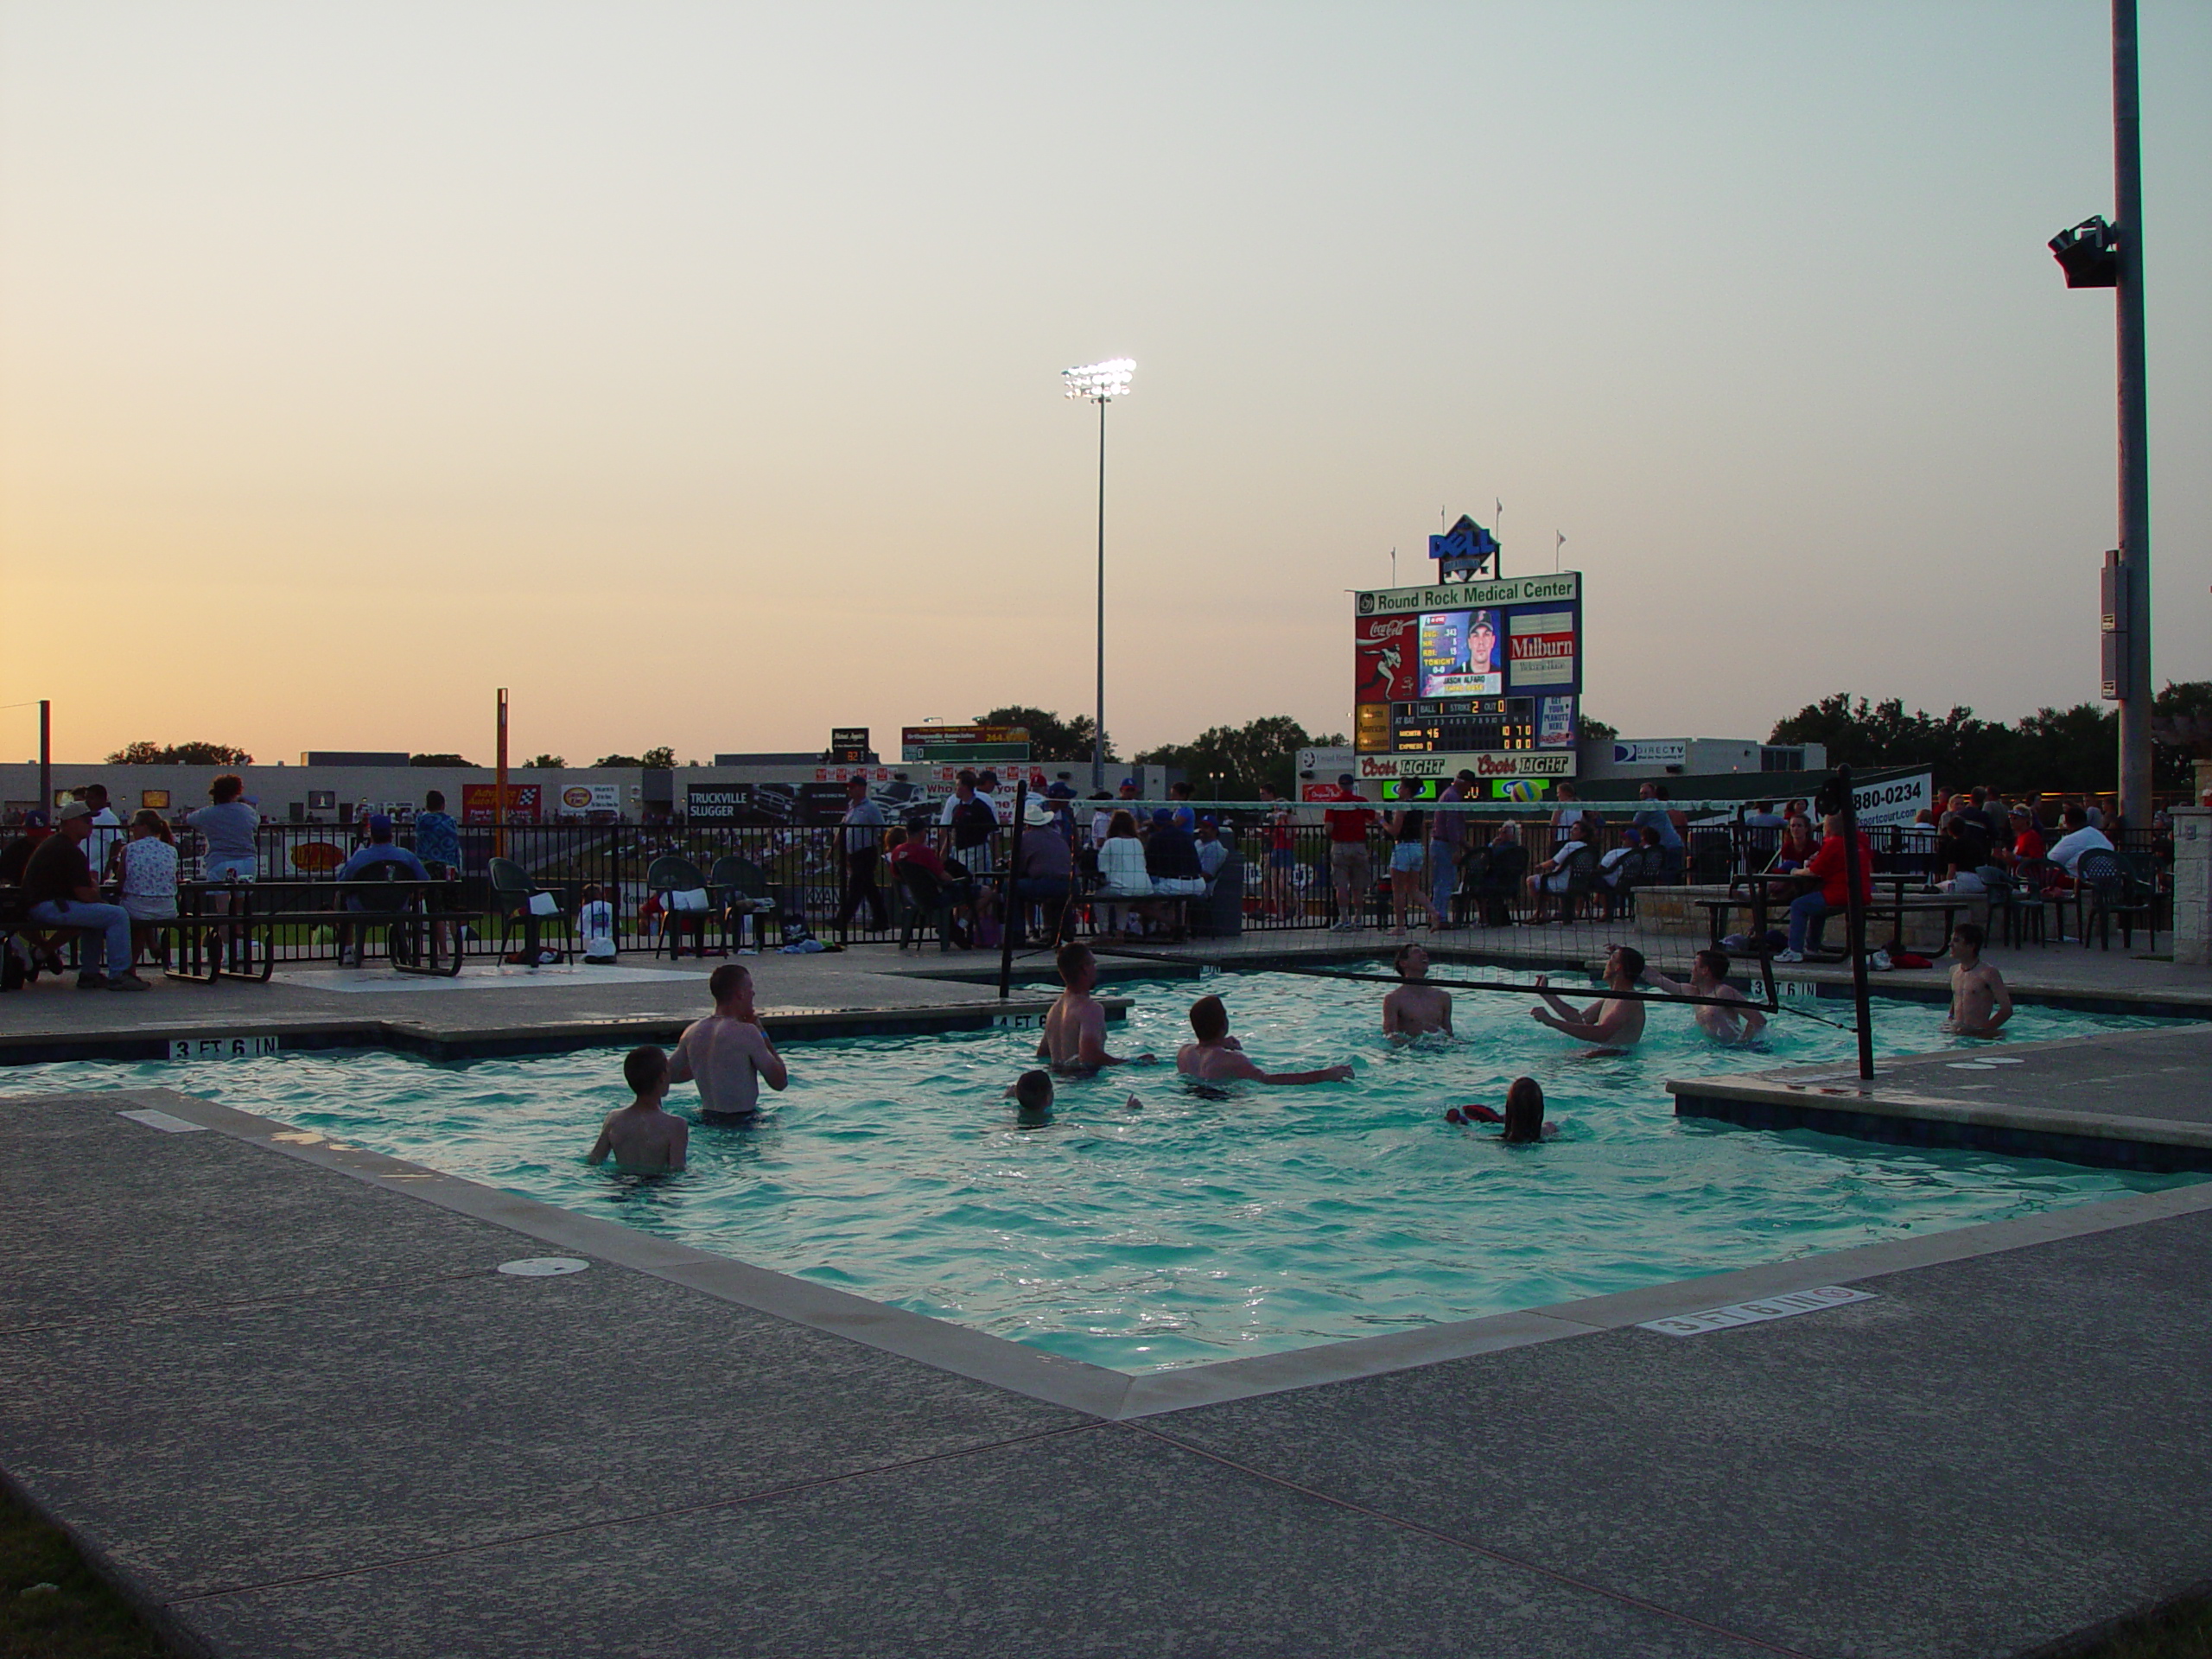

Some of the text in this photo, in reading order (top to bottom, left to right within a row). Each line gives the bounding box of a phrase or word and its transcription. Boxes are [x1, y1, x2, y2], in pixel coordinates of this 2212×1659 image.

[1429, 529, 1495, 559] DELL
[1378, 582, 1573, 611] Round Rock Medical Center
[1512, 636, 1573, 658] Milburn
[1424, 658, 1455, 666] TONIGHT
[1420, 704, 1436, 713] BALL
[1450, 702, 1471, 712] STRIKE
[1471, 701, 1479, 714] 2
[1484, 702, 1497, 711] OUT
[1497, 699, 1504, 713] 0
[1548, 704, 1564, 713] YOUR
[1543, 713, 1569, 722] PEANUTS
[847, 751, 858, 762] 82
[1637, 746, 1684, 754] DIRECTV
[1361, 756, 1445, 777] Coors LIGHT
[1478, 753, 1569, 776] Coors LIGHT
[927, 785, 952, 793] Who
[690, 792, 747, 804] TRUCKVILLE
[690, 805, 734, 817] SLUGGER
[1787, 982, 1796, 995] 6
[1802, 982, 1815, 996] IN
[1015, 1015, 1032, 1028] FT
[176, 1037, 276, 1057] 3 FT 6 IN
[1657, 1319, 1700, 1332] 3
[1689, 1310, 1748, 1325] FT
[1738, 1304, 1784, 1316] 6
